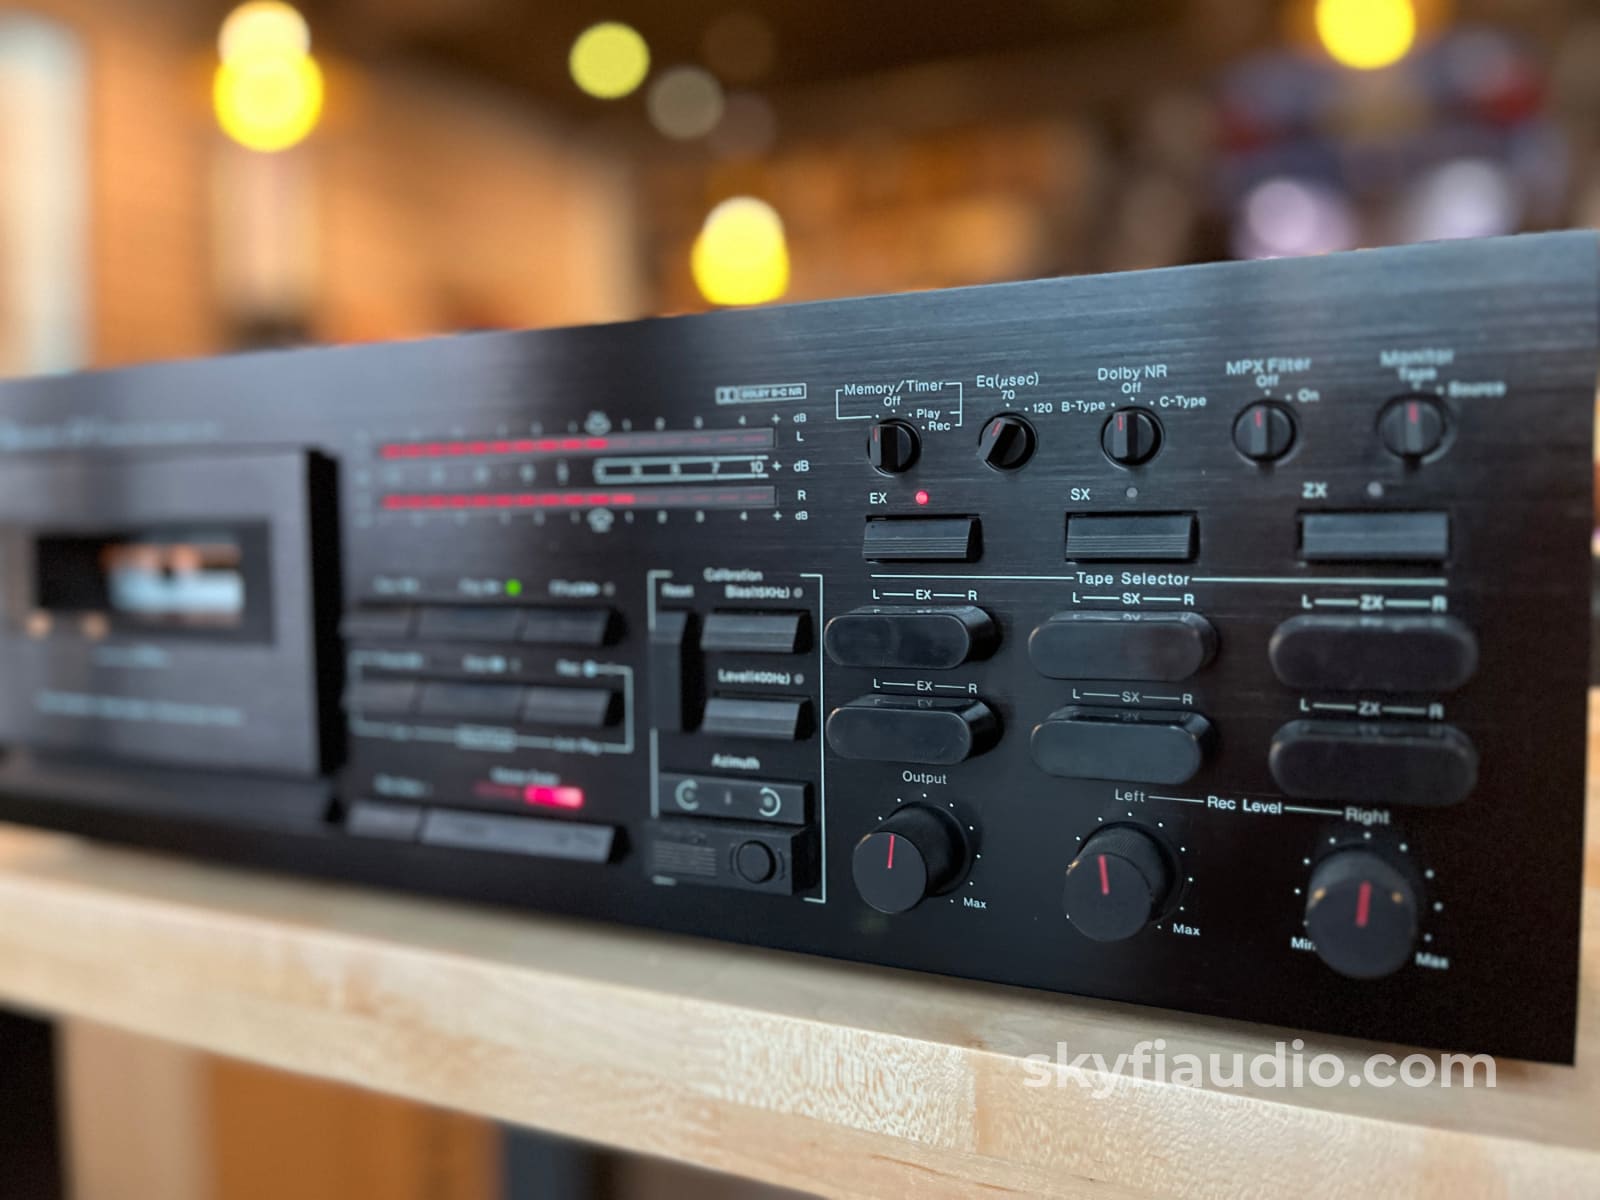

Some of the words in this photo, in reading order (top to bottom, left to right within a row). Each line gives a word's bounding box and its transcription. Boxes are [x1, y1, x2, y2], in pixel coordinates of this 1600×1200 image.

[1226, 360, 1264, 376] MPX
[1267, 357, 1312, 373] Filter
[1097, 366, 1141, 384] Dolby
[1144, 364, 1168, 379] NR
[1256, 374, 1280, 388] Off
[1121, 382, 1142, 394] Off
[883, 396, 901, 407] Off
[1001, 390, 1015, 400] 70
[1298, 389, 1320, 402] On
[1033, 403, 1053, 413] 120
[1061, 400, 1106, 414] B-Type
[1159, 396, 1207, 409] C-Type
[793, 412, 807, 423] dB
[916, 408, 941, 420] Play
[928, 421, 950, 431] Rec
[796, 430, 804, 442] L
[749, 460, 764, 474] 10
[793, 459, 810, 472] dB
[797, 489, 807, 501] R
[1070, 489, 1090, 501] SX
[1302, 482, 1328, 498] ZX
[870, 493, 888, 504] EX
[795, 510, 809, 521] dB
[1076, 572, 1114, 587] Tape
[1121, 572, 1190, 586] Selector
[872, 589, 880, 600] L
[915, 589, 932, 600] EX
[968, 589, 978, 601] R
[1072, 592, 1081, 603] L
[1122, 593, 1141, 605] SX
[1184, 594, 1195, 606] R
[1302, 594, 1313, 609] L
[1359, 595, 1385, 611] ZX
[873, 678, 881, 690] L
[916, 680, 933, 691] EX
[968, 683, 978, 694] R
[1072, 688, 1081, 700] L
[1121, 691, 1140, 703] SX
[1182, 693, 1193, 705] R
[1300, 698, 1310, 711] L
[1359, 701, 1382, 716] ZX
[902, 770, 948, 786] Output
[1115, 788, 1145, 802] Left
[1207, 795, 1237, 811] Rec
[1242, 798, 1283, 814] Level
[1345, 806, 1391, 826] Right
[963, 897, 988, 910] Max
[1172, 923, 1201, 936] Max
